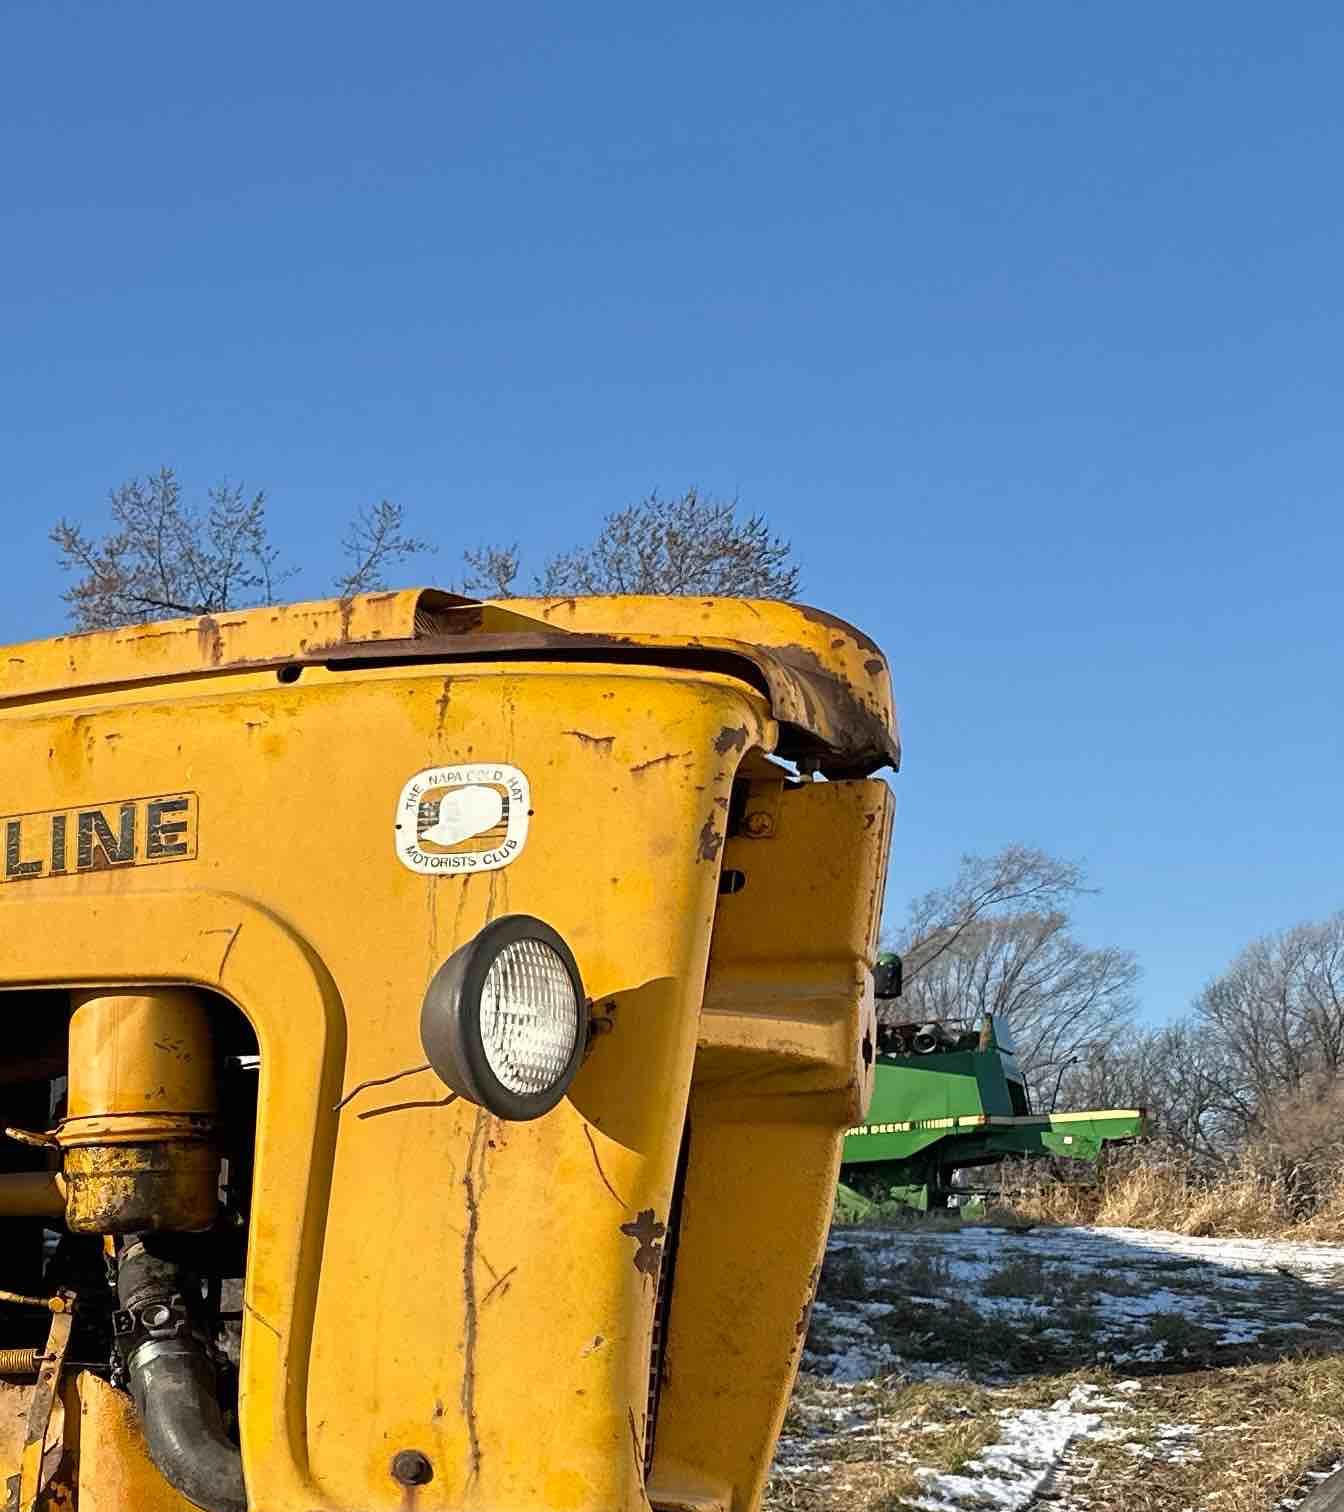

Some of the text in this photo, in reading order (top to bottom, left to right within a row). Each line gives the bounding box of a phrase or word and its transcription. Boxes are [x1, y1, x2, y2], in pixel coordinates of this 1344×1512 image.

[405, 784, 424, 810] THE
[429, 771, 462, 785] NAPA
[509, 776, 523, 803] HAT
[405, 840, 517, 868] MOTORISTS CLUB
